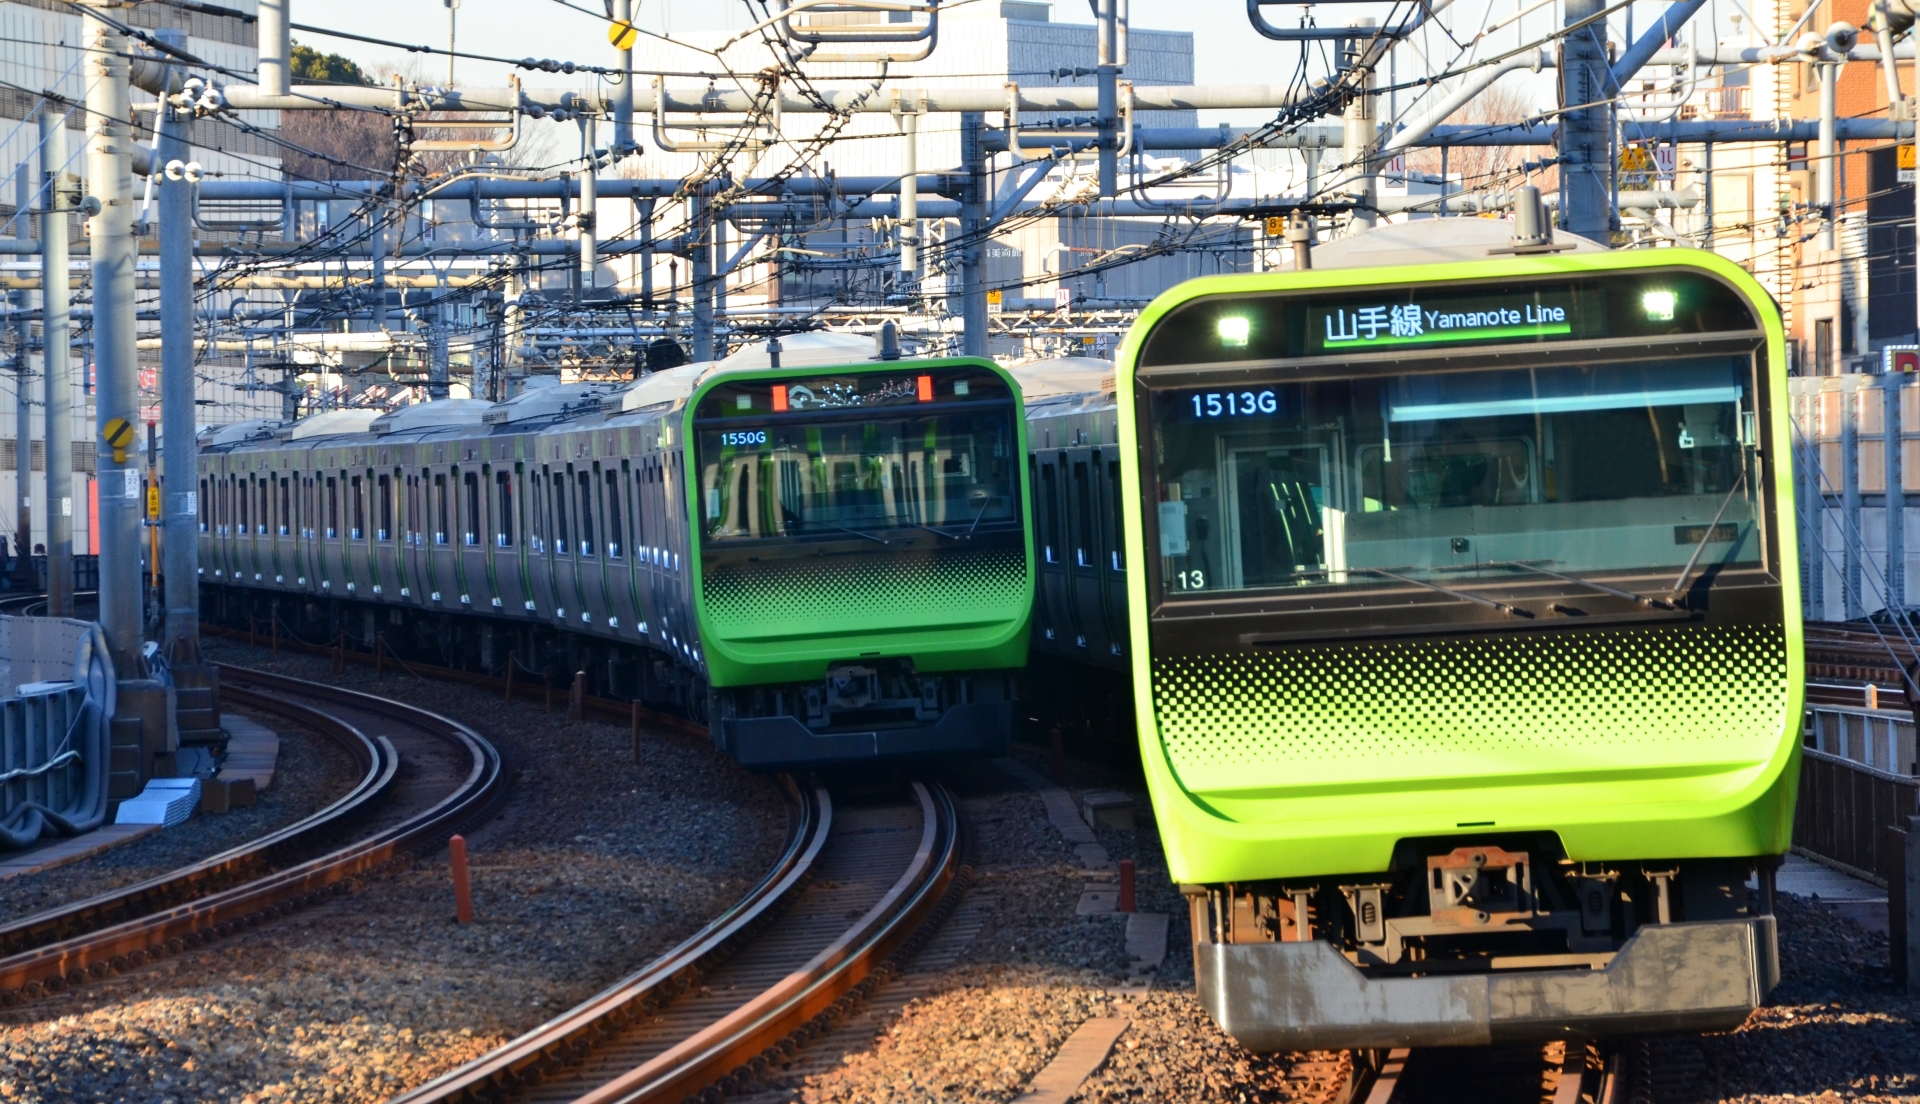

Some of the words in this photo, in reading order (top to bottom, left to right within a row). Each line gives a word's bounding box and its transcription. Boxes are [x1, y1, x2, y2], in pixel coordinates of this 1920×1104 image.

[1902, 146, 1911, 158] 7
[1270, 218, 1277, 228] 8
[1325, 304, 1424, 341] 山手線
[1424, 307, 1521, 329] Yamanote
[1526, 305, 1565, 324] Line
[1192, 390, 1277, 417] 1513G
[721, 431, 767, 446] 1550G
[127, 477, 138, 485] 22
[715, 525, 729, 535] 24
[1178, 569, 1204, 590] 13
